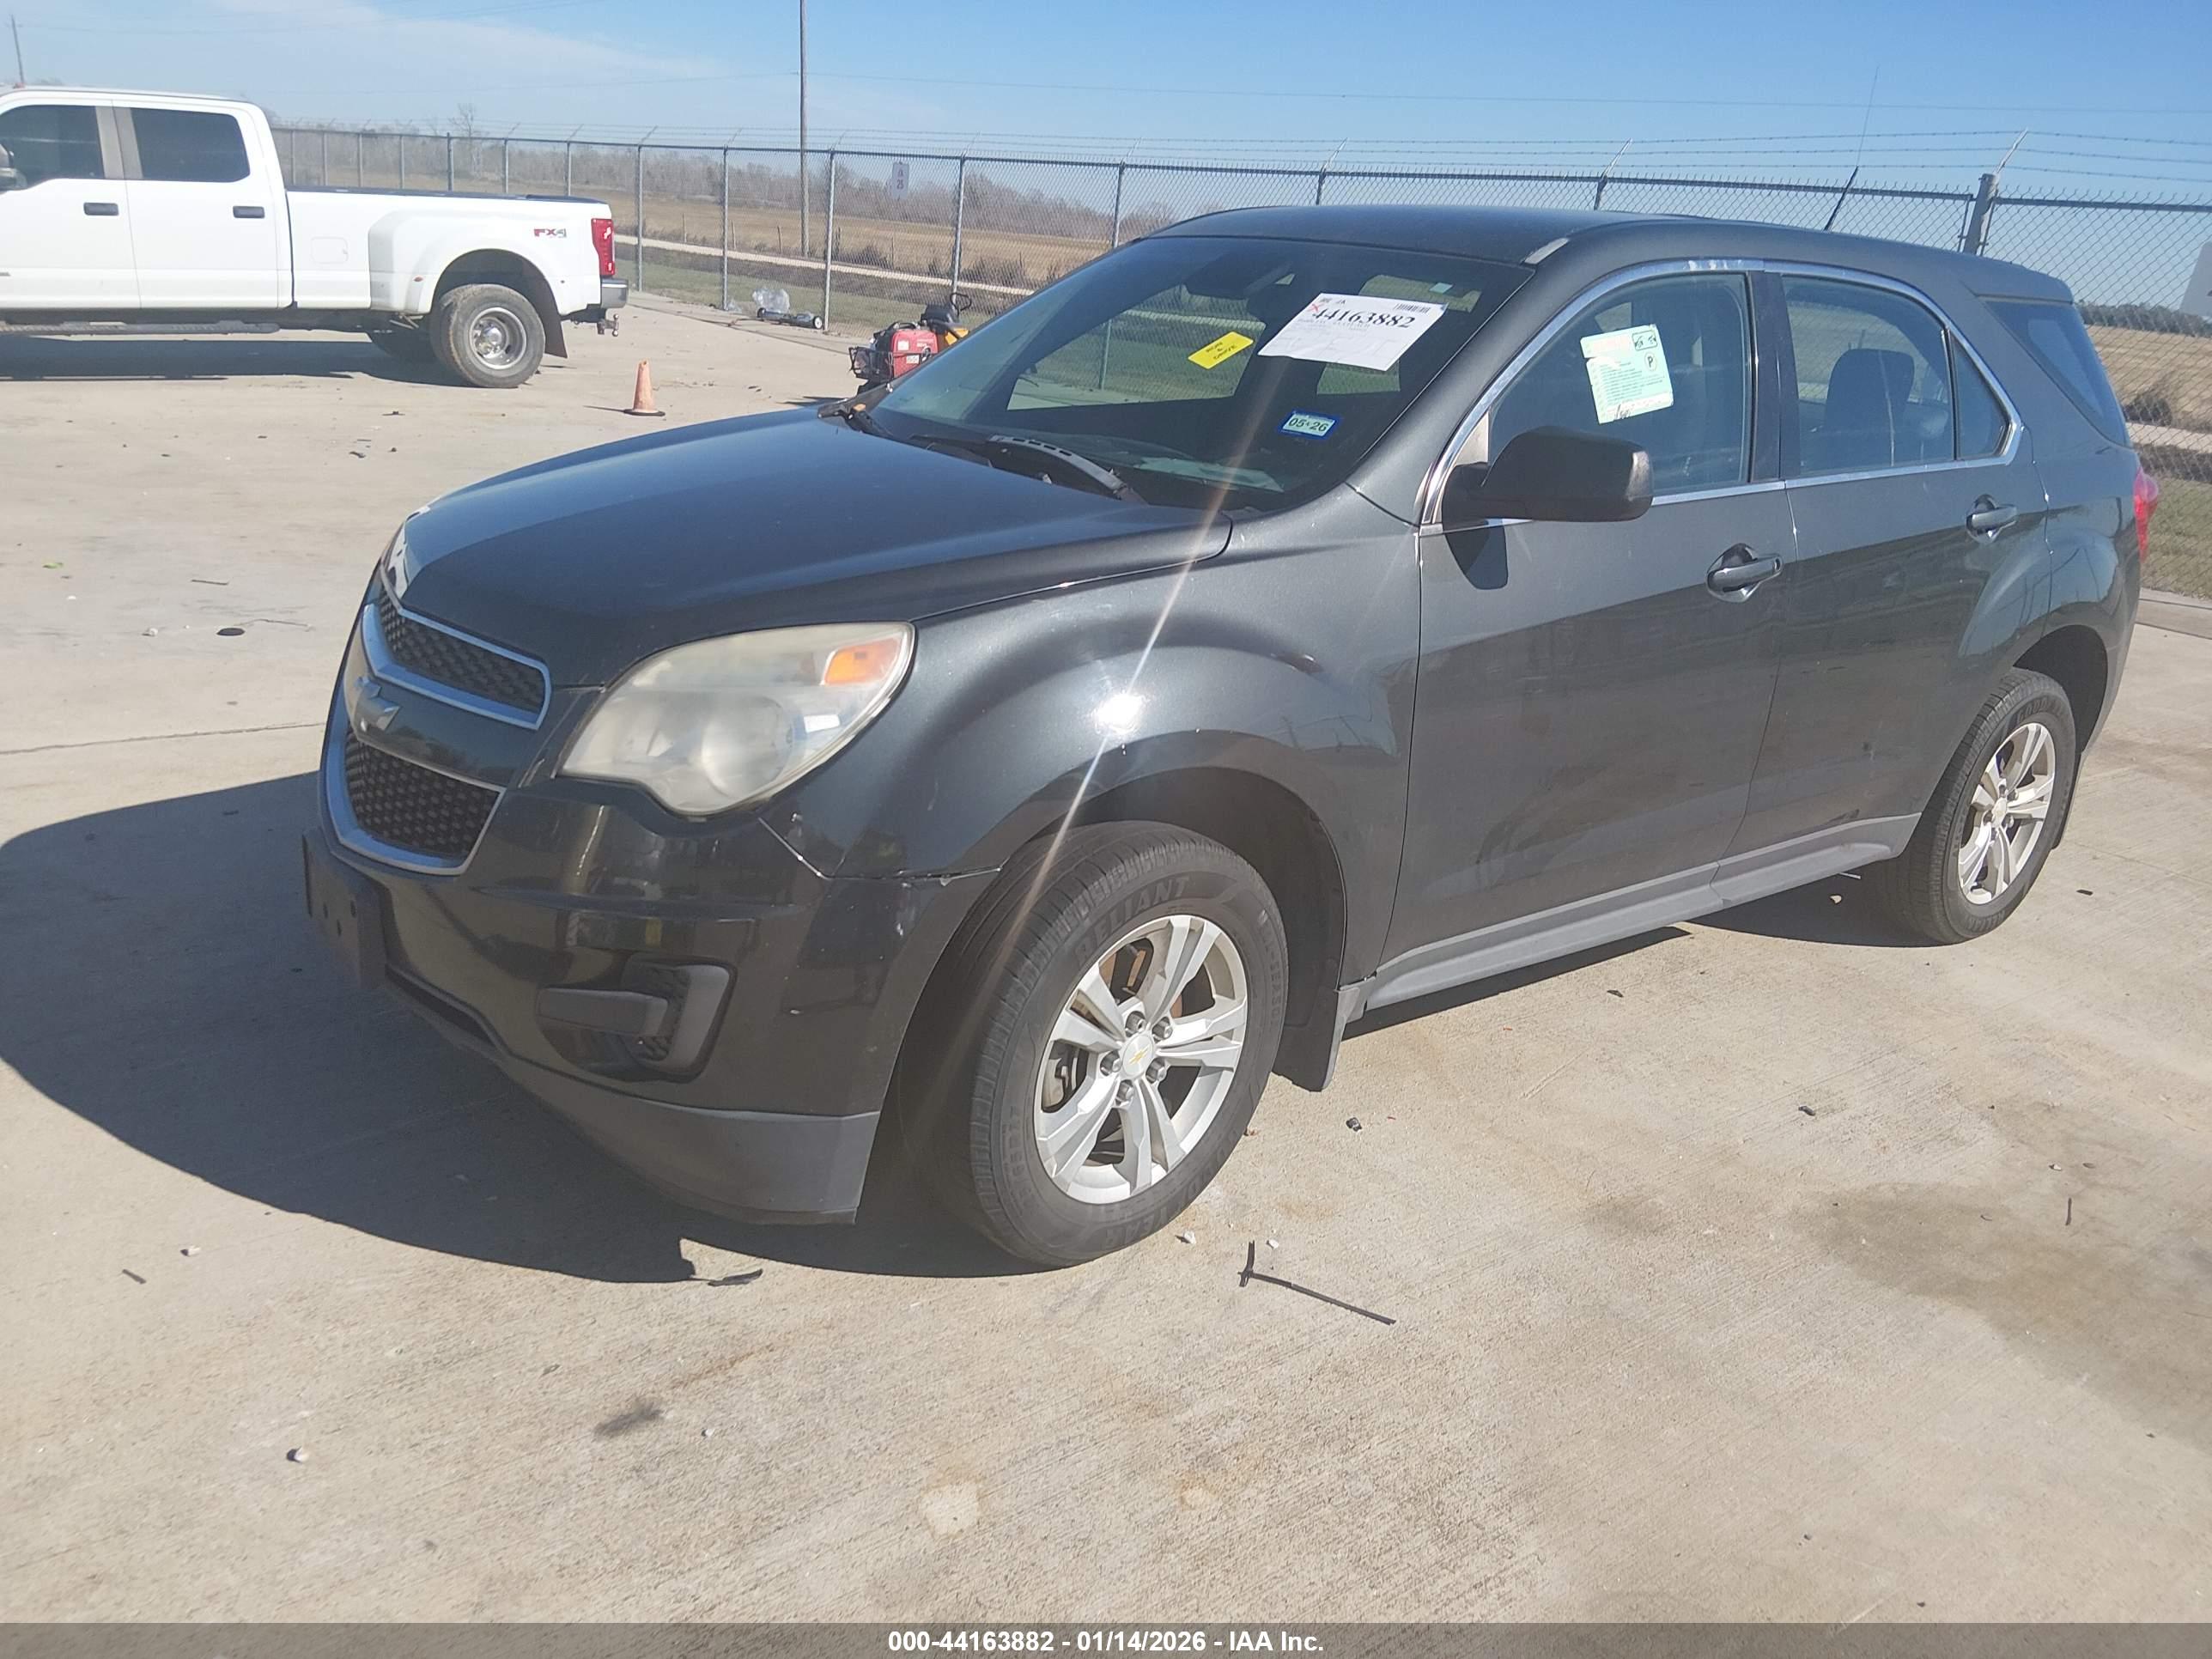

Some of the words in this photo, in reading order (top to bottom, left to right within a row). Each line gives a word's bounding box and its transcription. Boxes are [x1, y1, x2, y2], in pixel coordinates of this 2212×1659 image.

[533, 228, 567, 238] FX4
[1312, 307, 1415, 328] 44163882
[1288, 417, 1307, 428] 05
[1309, 421, 1329, 432] 26
[1073, 875, 1191, 966] RELIANT
